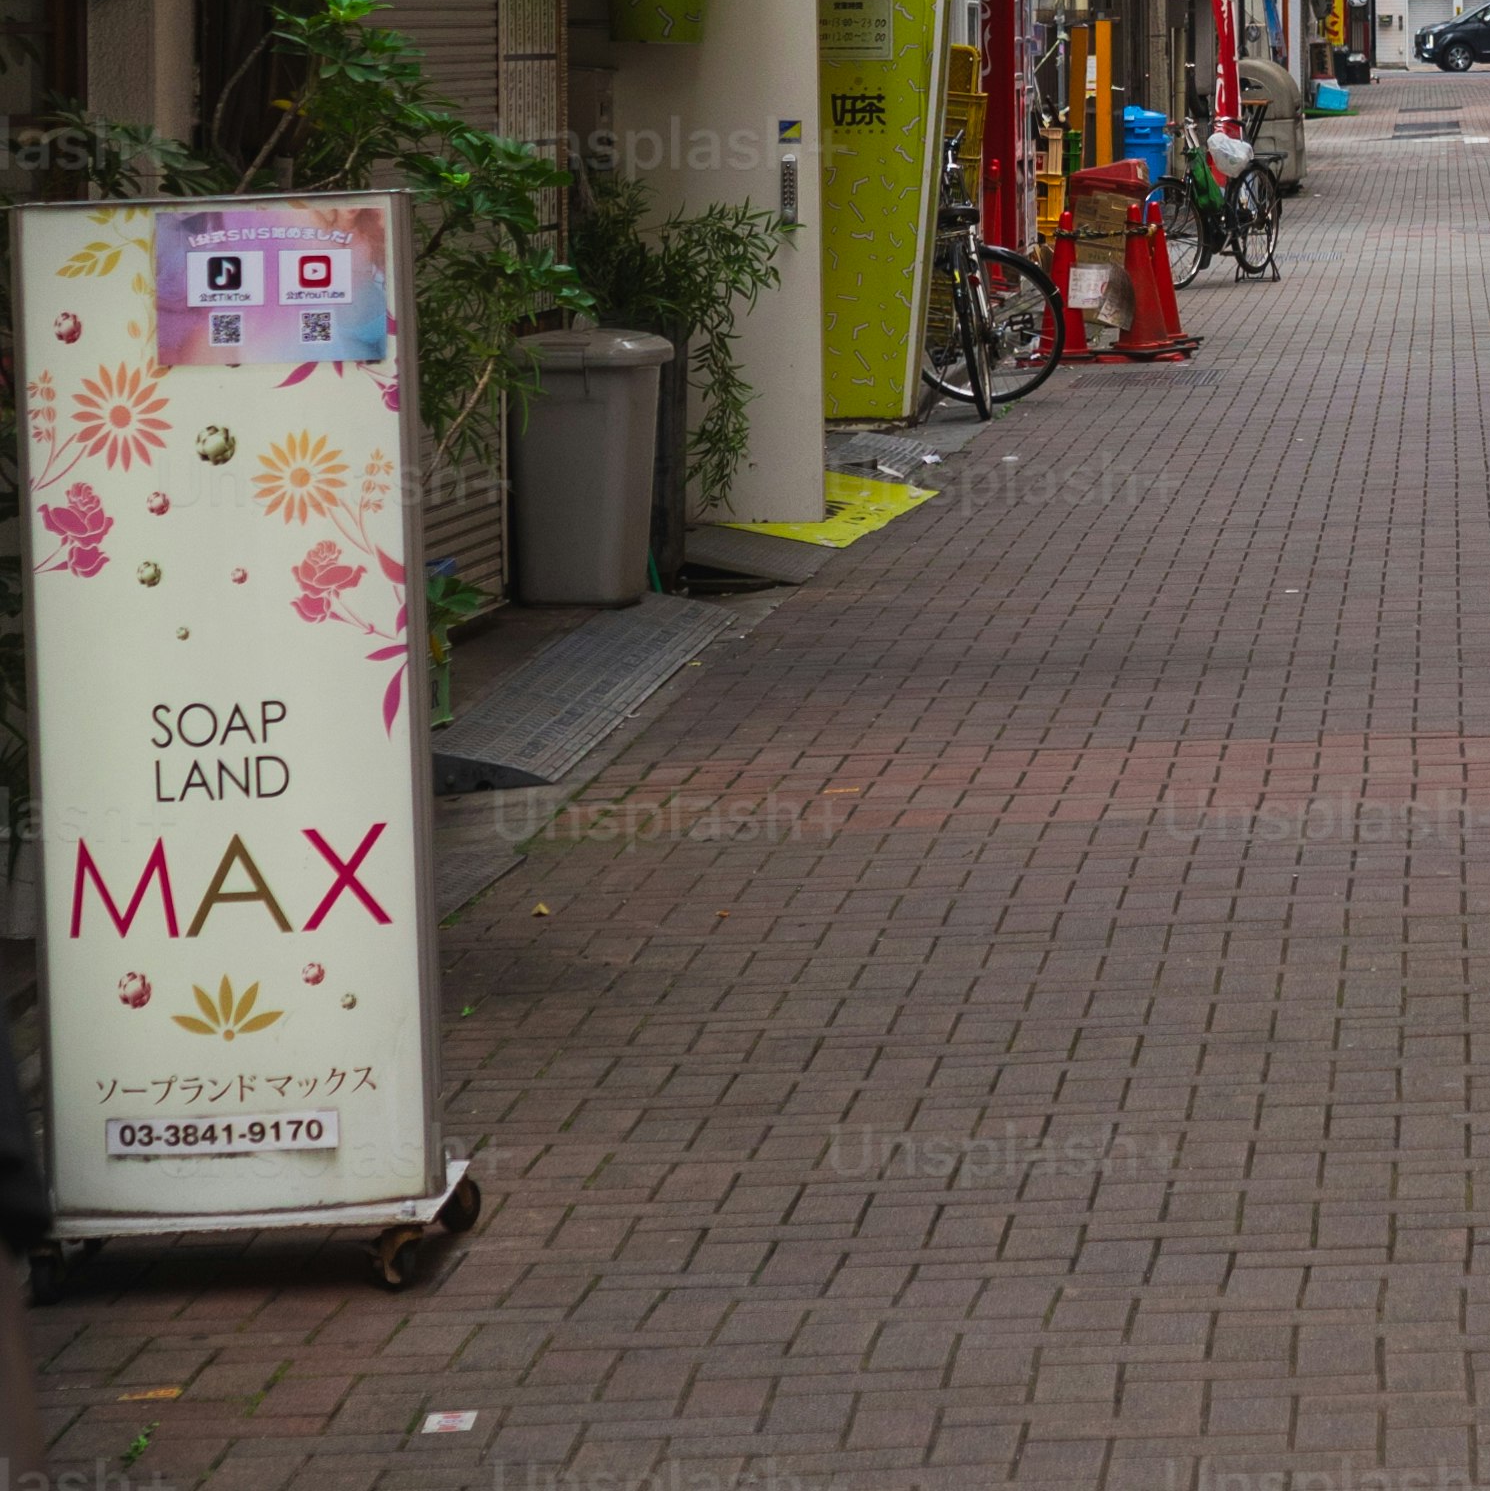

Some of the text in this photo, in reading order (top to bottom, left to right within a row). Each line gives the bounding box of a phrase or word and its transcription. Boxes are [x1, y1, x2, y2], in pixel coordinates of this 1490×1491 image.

[151, 700, 288, 749] SOAP
[155, 755, 290, 803] LAND
[70, 822, 394, 939] MAX
[96, 1064, 378, 1107] ソープランド マックス
[118, 1118, 325, 1148] 03-3841-9170
